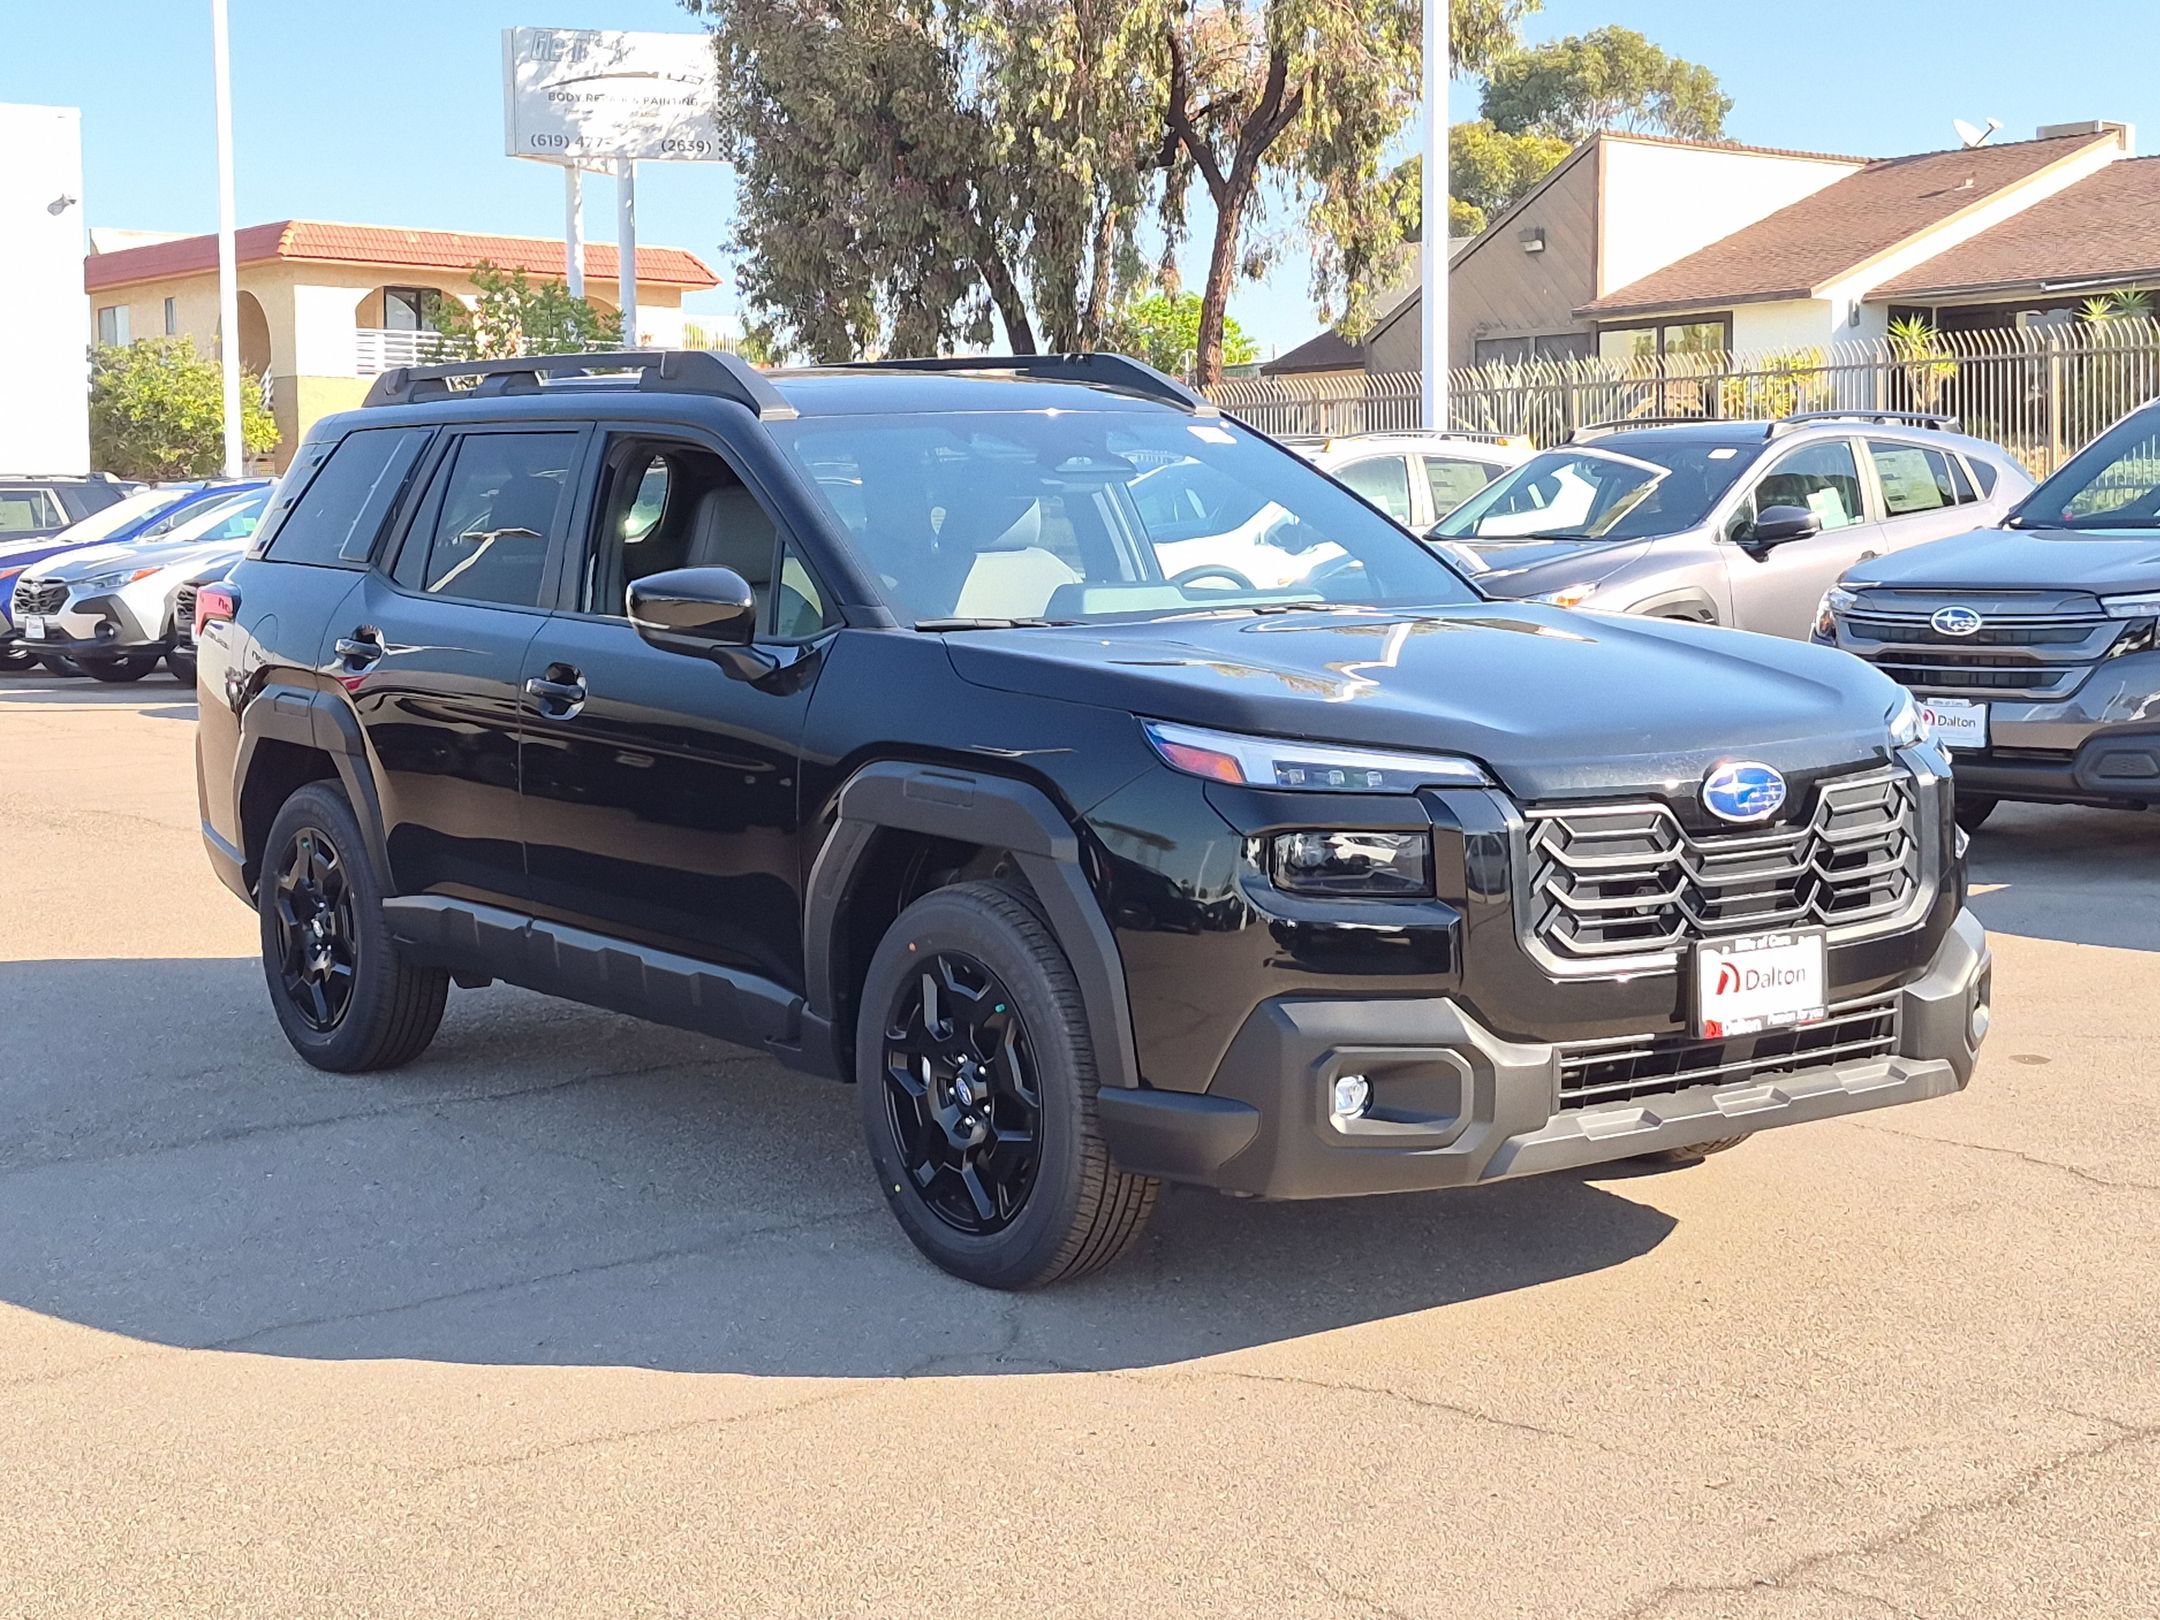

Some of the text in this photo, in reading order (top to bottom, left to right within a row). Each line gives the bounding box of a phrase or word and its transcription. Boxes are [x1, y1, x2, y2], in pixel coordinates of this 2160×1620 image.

[548, 91, 582, 103] BODY
[585, 92, 628, 104] REAR
[530, 132, 570, 150] (619)
[660, 138, 713, 153] (2639)
[1937, 714, 1976, 728] Dalton
[1745, 966, 1806, 991] Dalton
